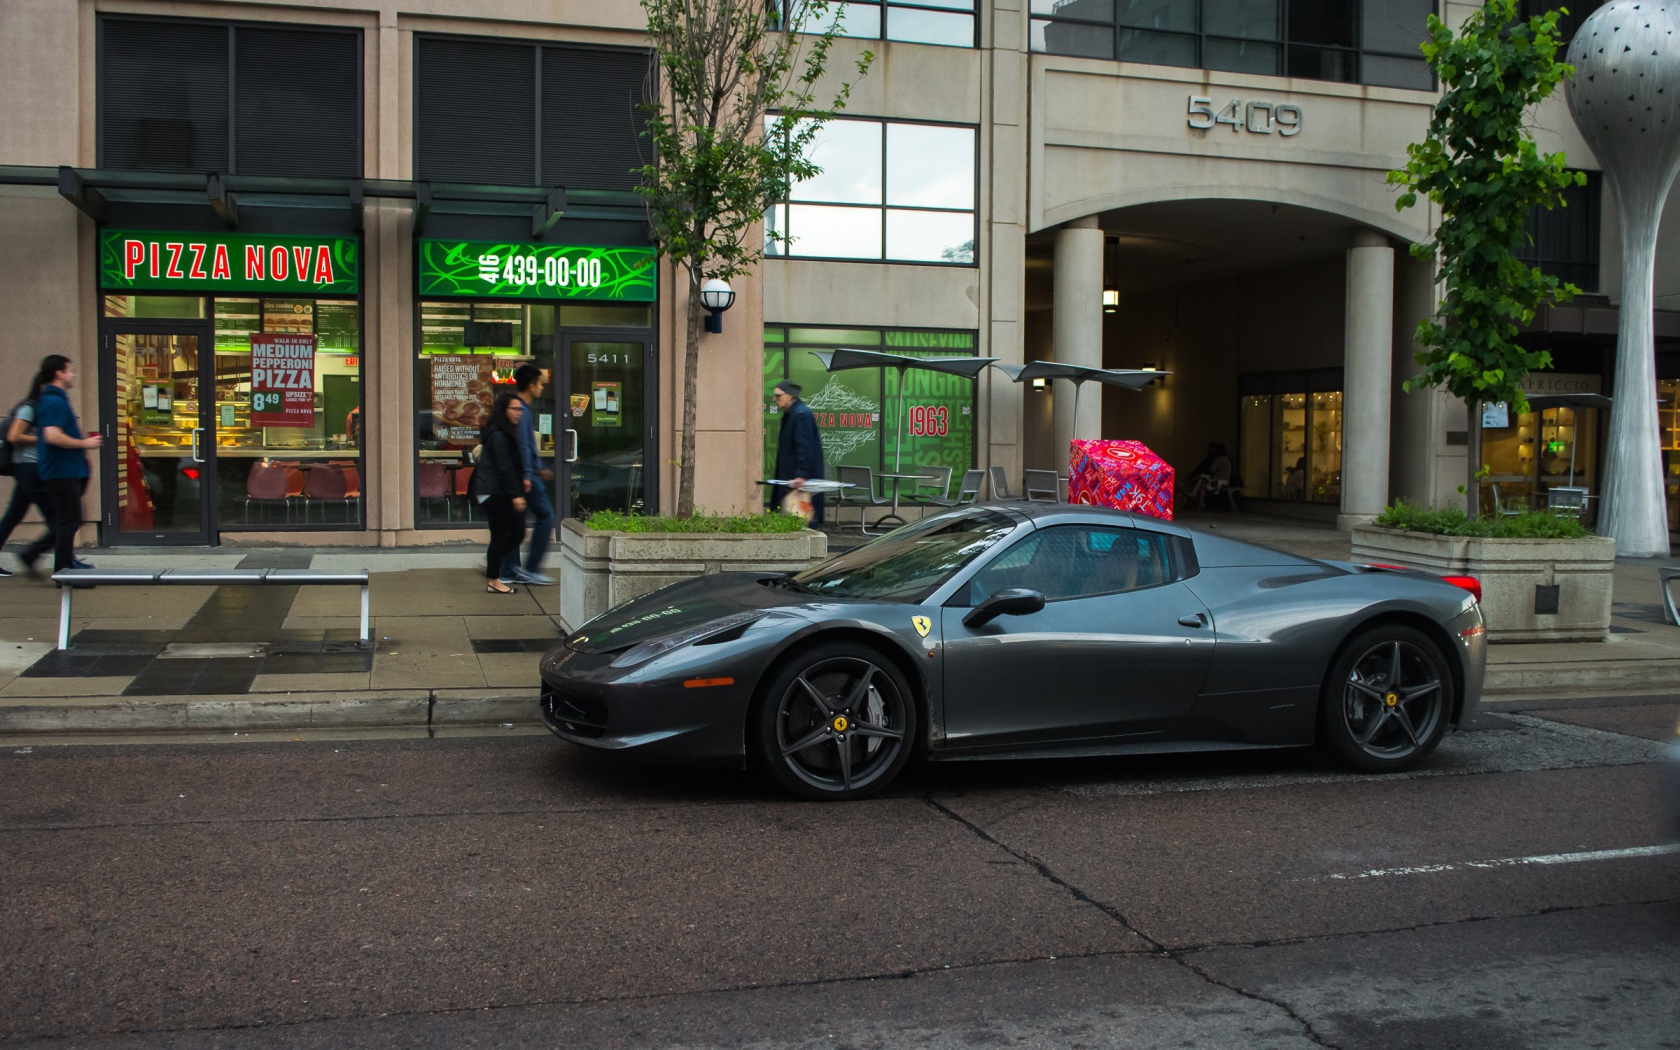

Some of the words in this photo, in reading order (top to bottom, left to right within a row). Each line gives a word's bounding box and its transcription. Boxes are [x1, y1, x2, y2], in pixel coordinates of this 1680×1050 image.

[1188, 95, 1303, 136] 5409
[124, 239, 231, 280] PIZZA
[245, 244, 334, 284] NOVA
[478, 254, 500, 284] 416
[502, 255, 601, 288] 439-00-00
[253, 344, 312, 358] MEDIUM
[587, 353, 629, 364] 5411
[253, 358, 312, 369] PEPPERONI
[434, 364, 455, 373] RAISED
[455, 364, 480, 373] WITHOUT
[253, 369, 312, 388] PIZZA
[434, 372, 469, 380] ANTIBIOTICS
[1517, 379, 1589, 391] APRICCIO
[839, 412, 873, 429] NOVA
[909, 405, 949, 437] 1963
[1128, 485, 1150, 512] T9K
